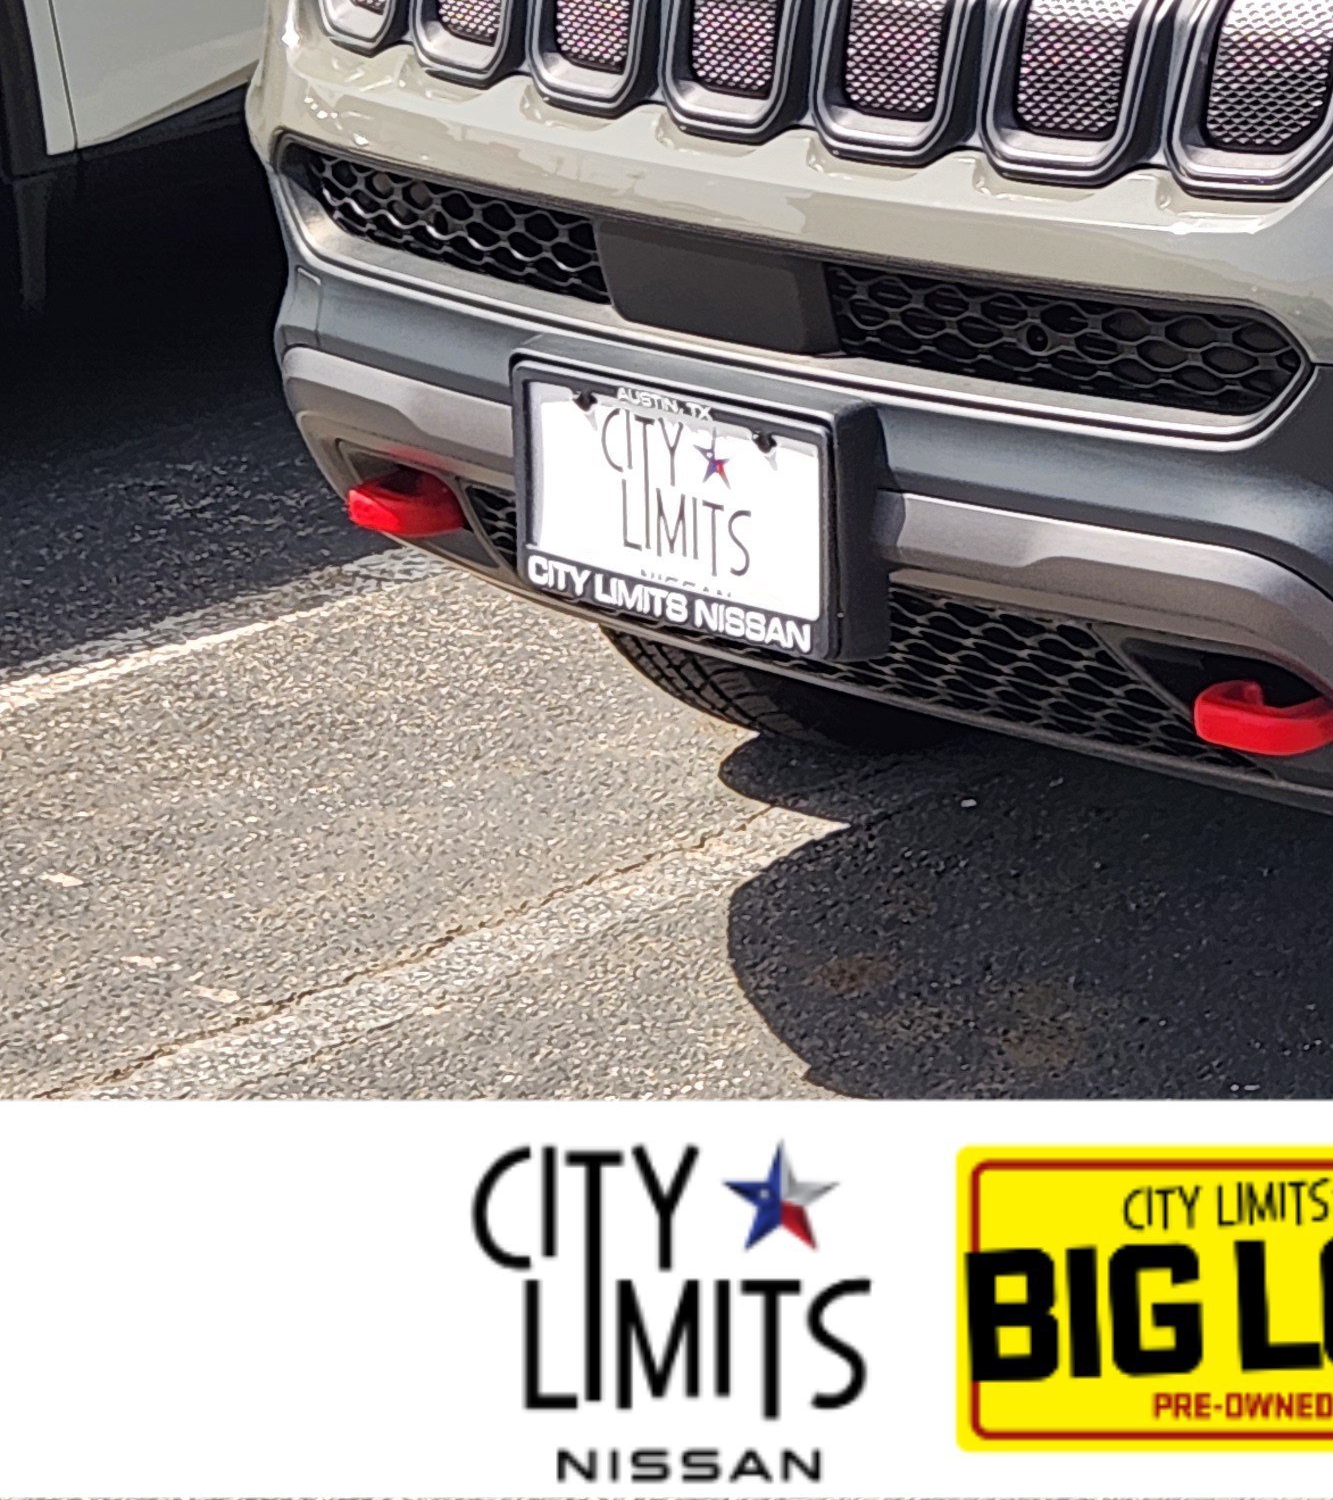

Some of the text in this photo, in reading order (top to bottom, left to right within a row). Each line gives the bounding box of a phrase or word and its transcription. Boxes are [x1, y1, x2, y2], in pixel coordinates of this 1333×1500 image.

[601, 408, 684, 487] CITY
[686, 402, 714, 421] TX
[622, 478, 752, 577] LIMITS
[527, 554, 592, 596] CITY
[595, 573, 688, 623] LIMITS
[694, 598, 812, 653] NISSAN
